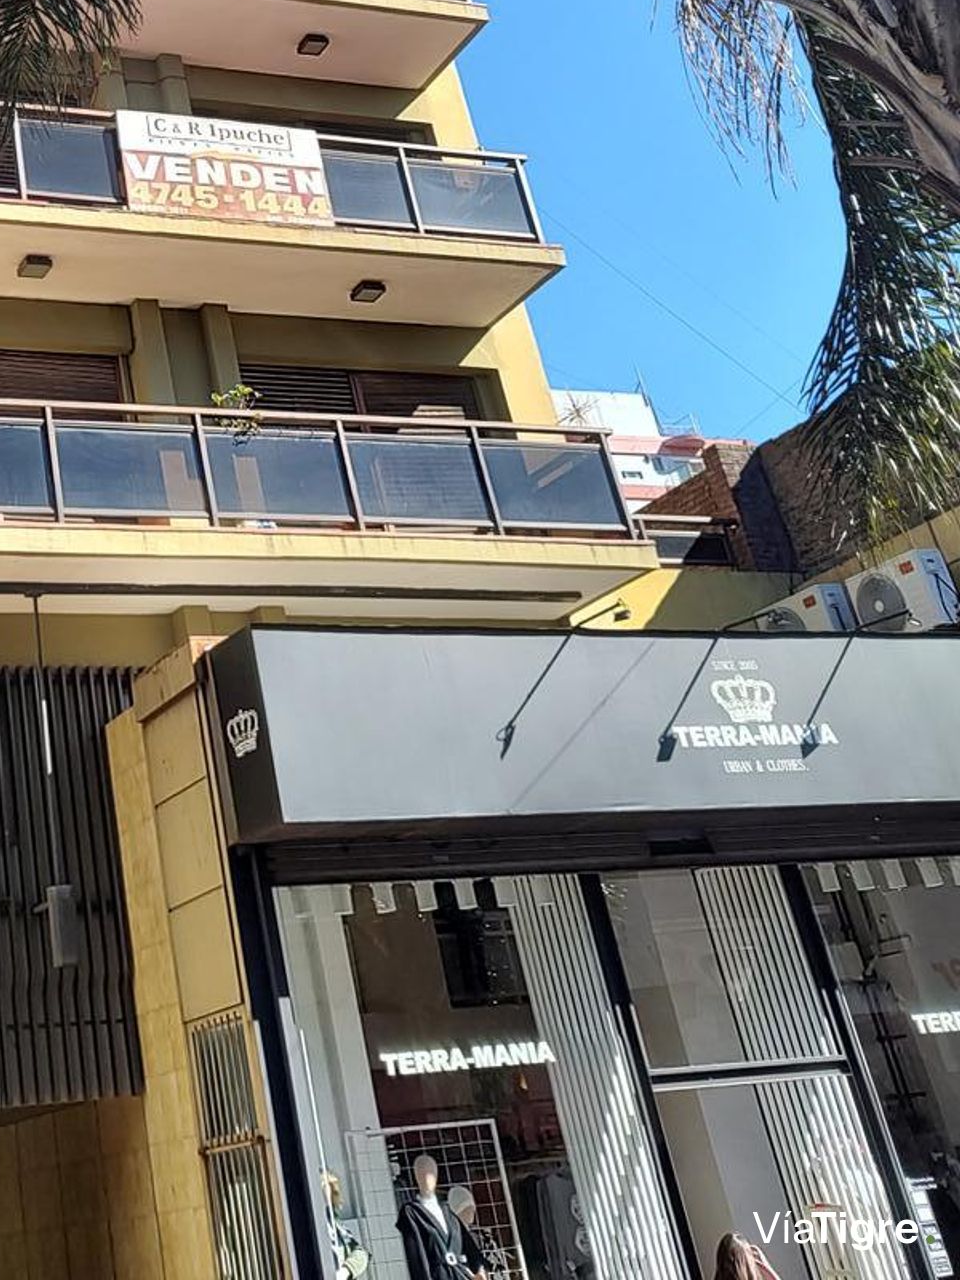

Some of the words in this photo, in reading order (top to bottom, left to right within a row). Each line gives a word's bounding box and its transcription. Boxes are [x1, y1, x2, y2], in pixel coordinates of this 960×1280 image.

[154, 118, 167, 133] C
[172, 123, 181, 134] &
[189, 122, 202, 136] R
[210, 124, 285, 145] Ipuche
[124, 154, 325, 195] VENDEN
[379, 1041, 556, 1076] TERRA-MANIA
